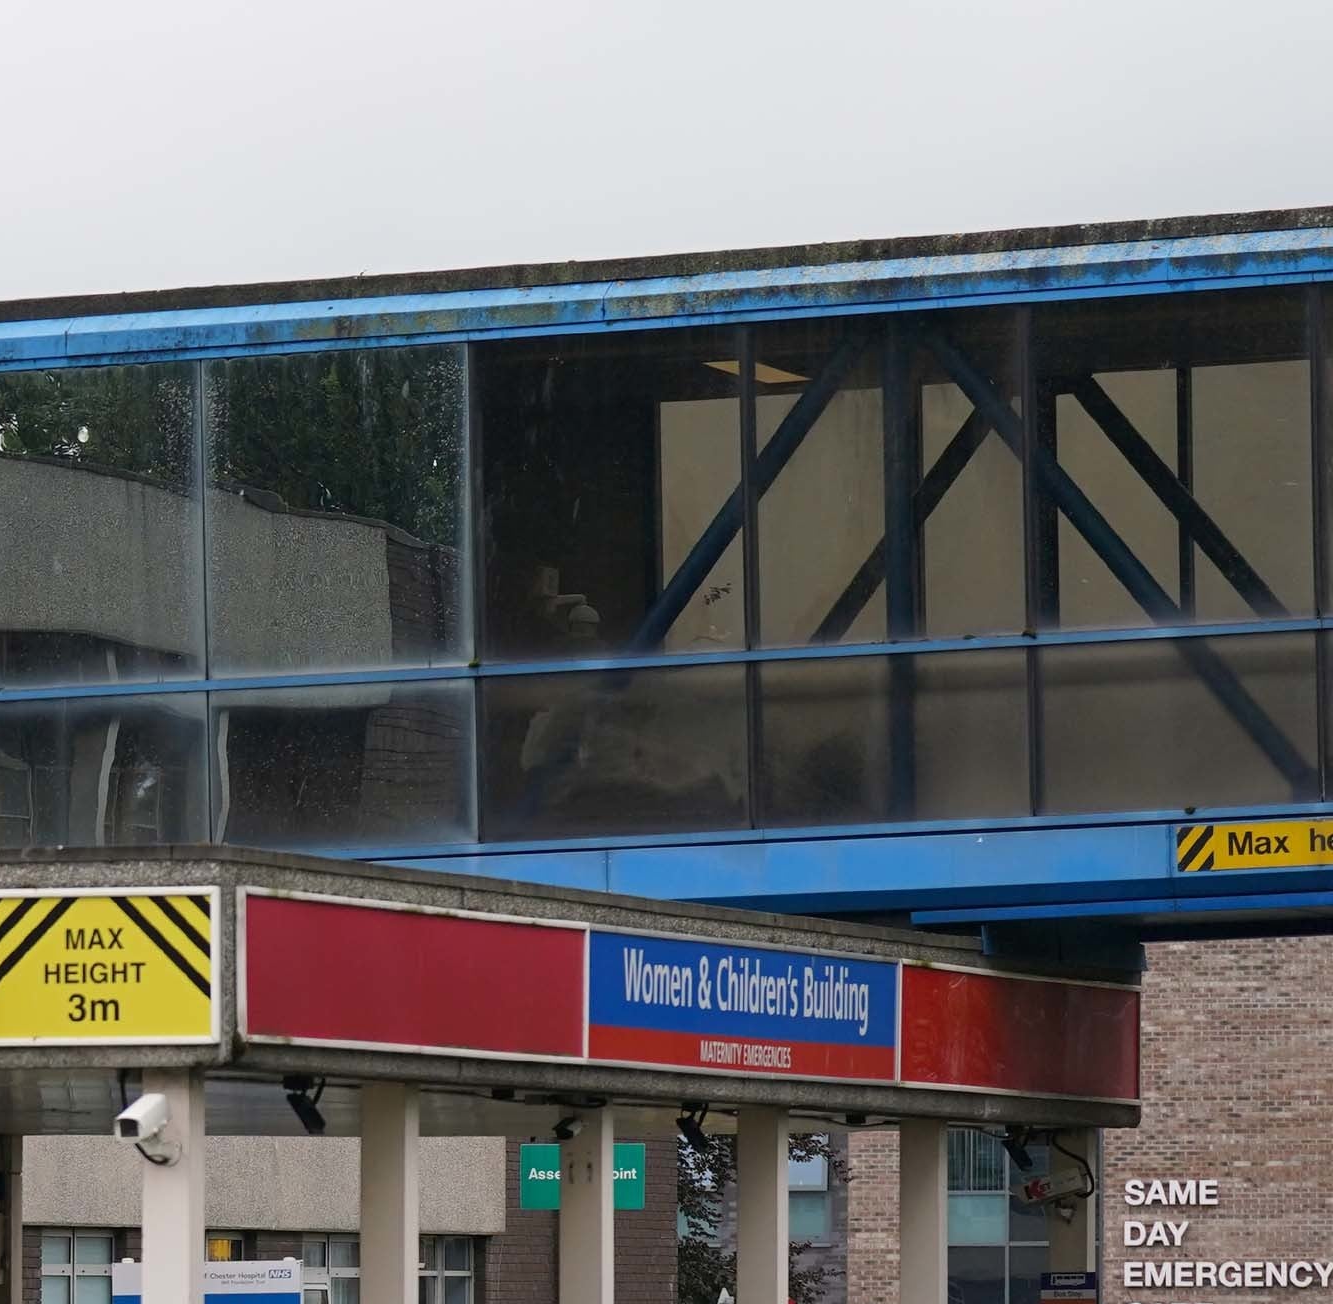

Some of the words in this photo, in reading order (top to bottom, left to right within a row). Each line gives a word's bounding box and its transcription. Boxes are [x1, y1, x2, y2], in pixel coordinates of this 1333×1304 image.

[1228, 831, 1290, 856] Max
[64, 928, 124, 951] MAX
[43, 961, 146, 985] HEIGHT
[623, 947, 693, 1008] Women
[697, 955, 712, 1010] &
[803, 966, 870, 1036] Building
[68, 994, 121, 1023] 3m
[700, 1040, 742, 1065] MATERNITY
[743, 1044, 792, 1070] EMERGENCIES
[528, 1168, 561, 1180] Asse
[613, 1168, 637, 1180] oint
[1124, 1179, 1220, 1206] SAME
[1124, 1221, 1189, 1247] DAY
[269, 1269, 291, 1279] NHS
[1123, 1261, 1333, 1288] EMERGENCY
